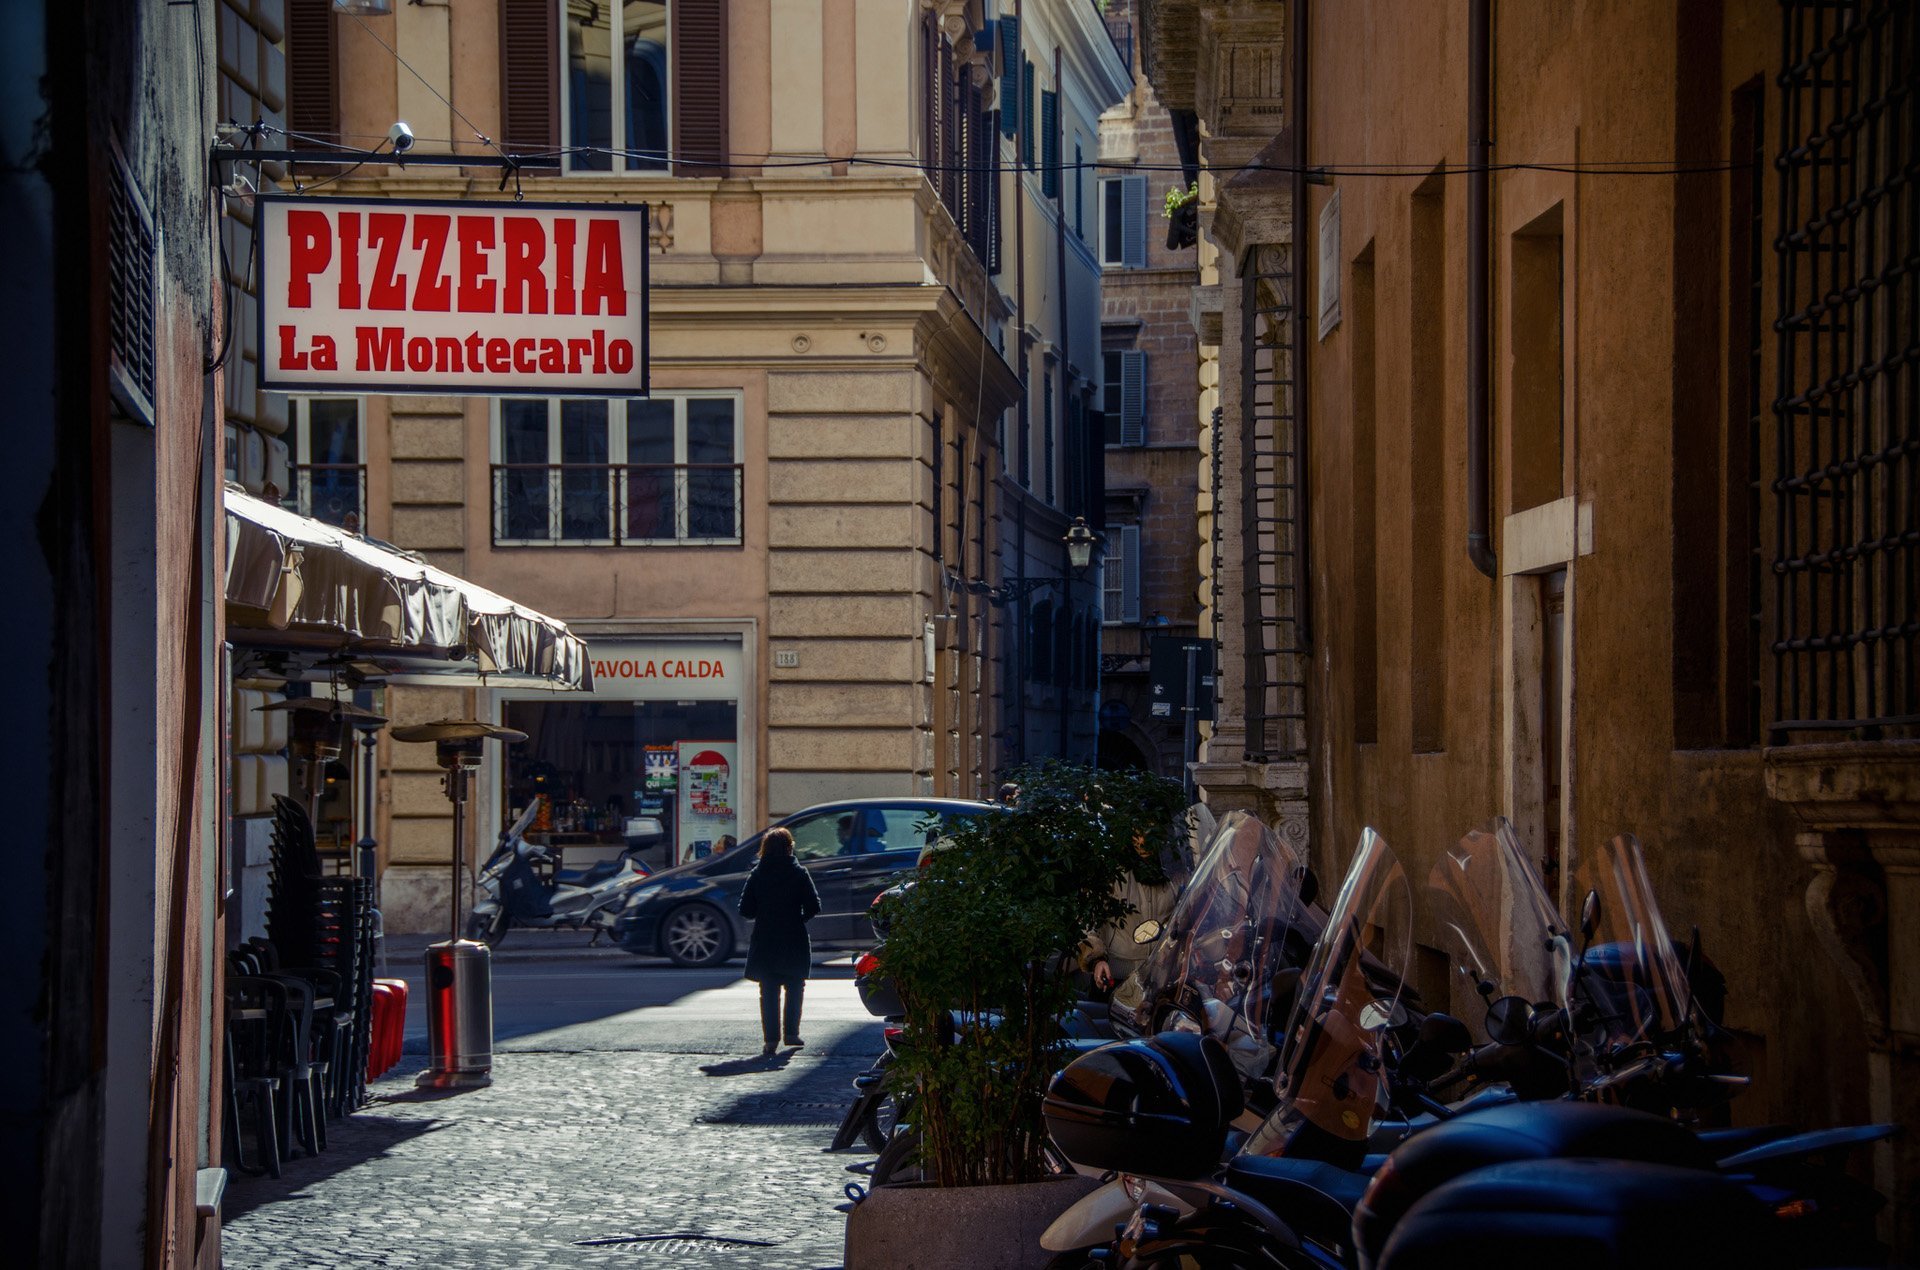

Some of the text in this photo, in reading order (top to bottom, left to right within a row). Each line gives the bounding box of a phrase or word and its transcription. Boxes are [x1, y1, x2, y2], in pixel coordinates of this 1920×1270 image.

[287, 209, 627, 316] PIZZERIA
[279, 325, 634, 374] La Montecarlo
[661, 660, 725, 678] CALDA
